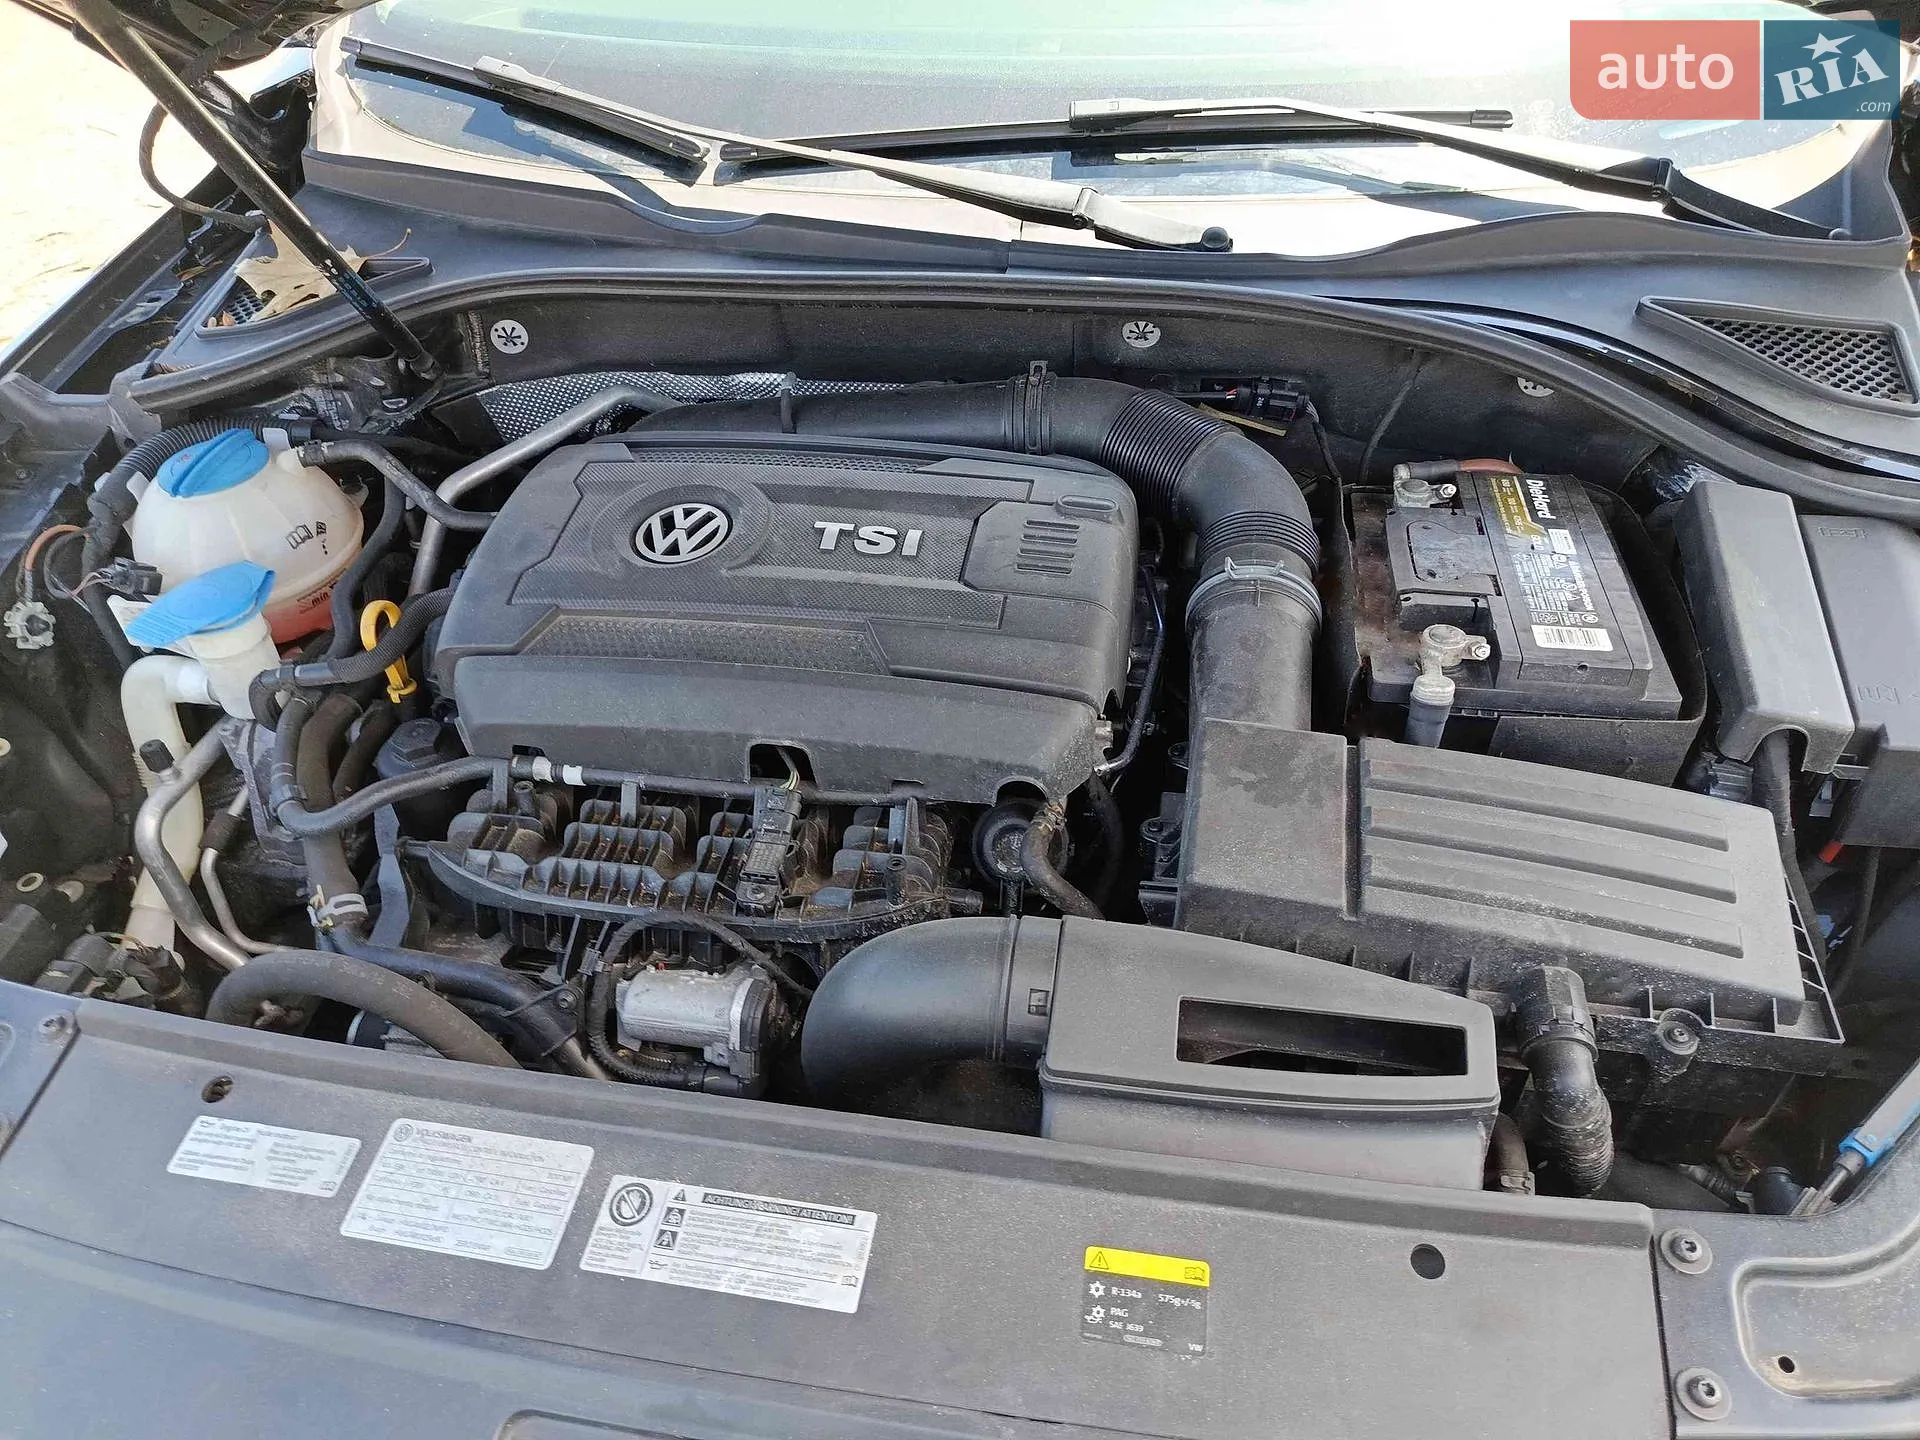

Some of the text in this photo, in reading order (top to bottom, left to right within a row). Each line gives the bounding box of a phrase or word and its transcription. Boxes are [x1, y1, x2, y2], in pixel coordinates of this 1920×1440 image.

[1526, 479, 1556, 519] DieHard
[813, 520, 925, 557] TSI
[311, 591, 329, 608] min
[1111, 1286, 1142, 1299] R-134a
[1109, 1307, 1129, 1317] PAG
